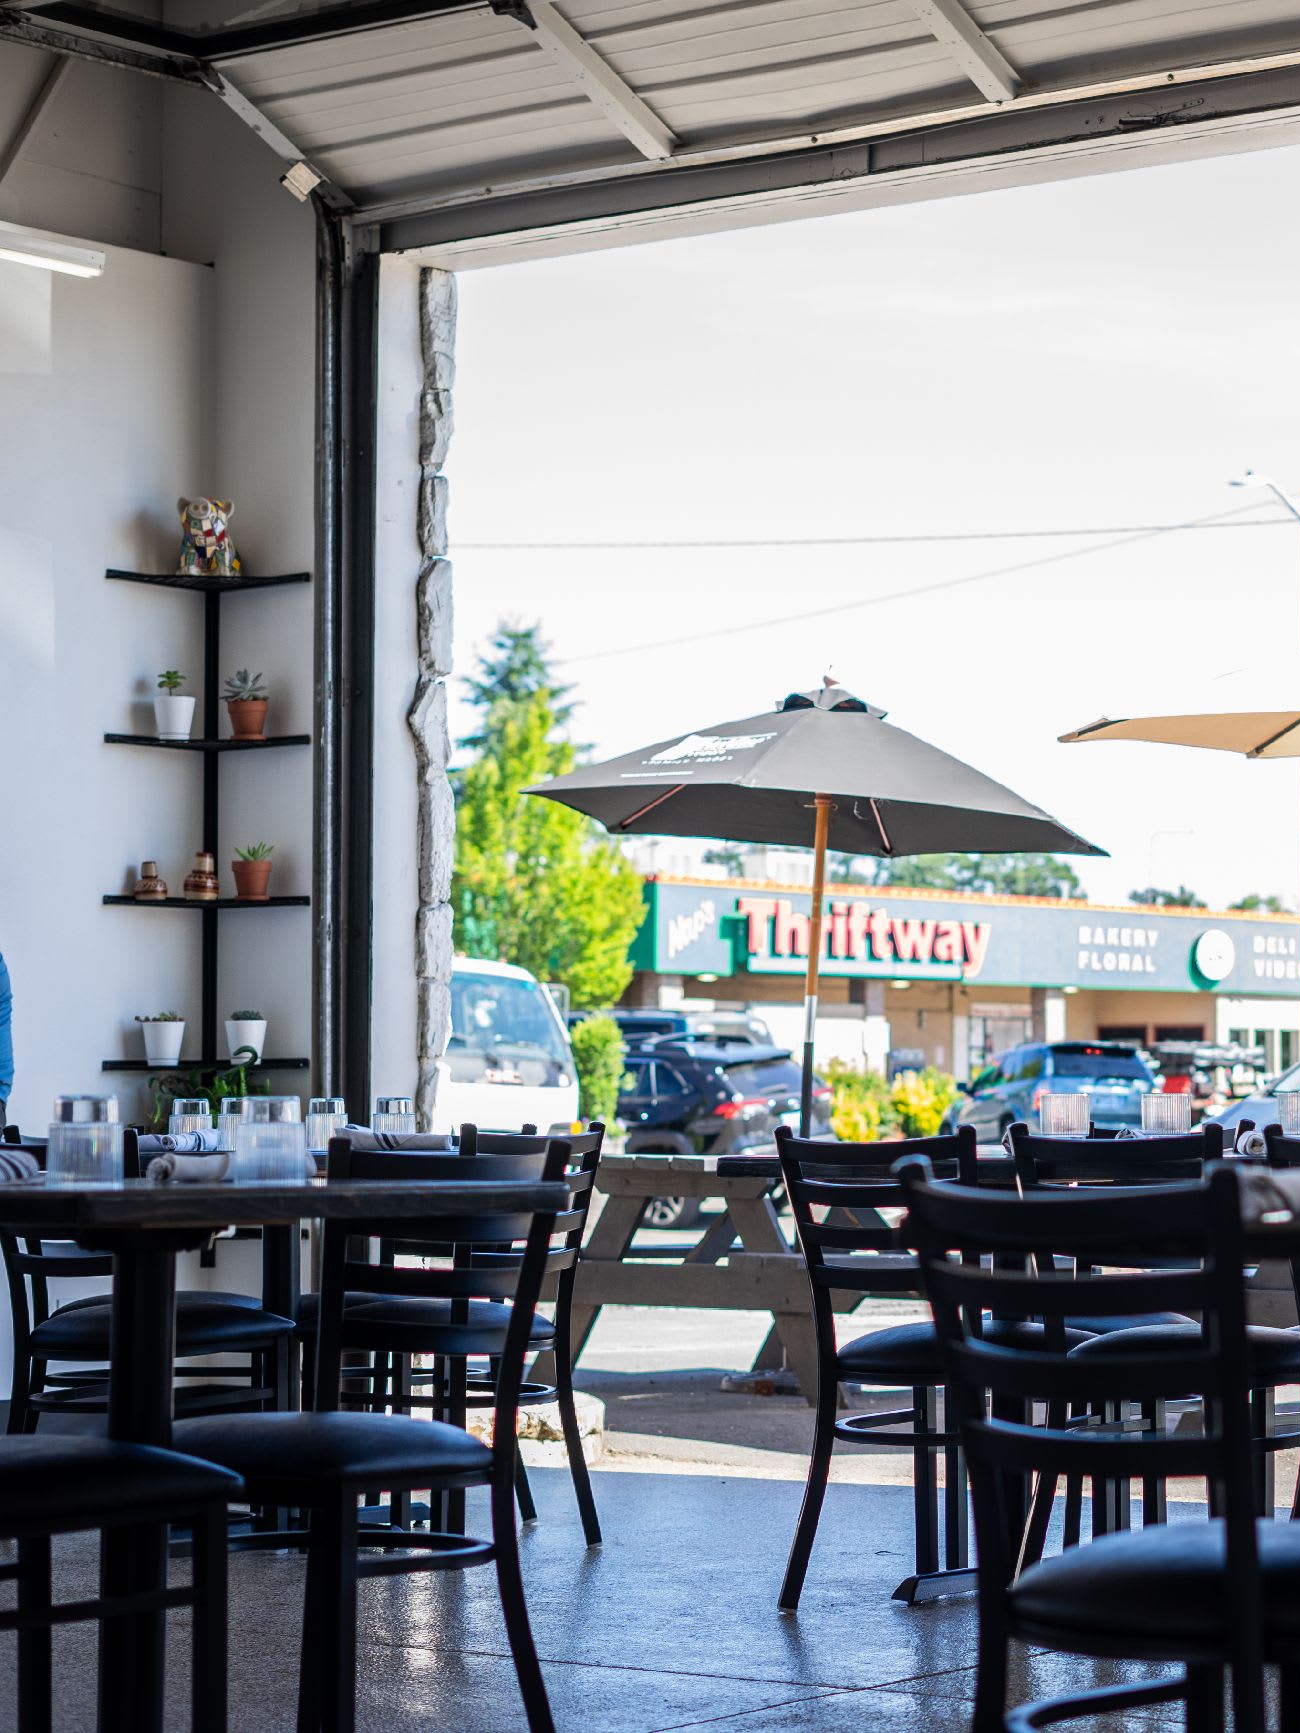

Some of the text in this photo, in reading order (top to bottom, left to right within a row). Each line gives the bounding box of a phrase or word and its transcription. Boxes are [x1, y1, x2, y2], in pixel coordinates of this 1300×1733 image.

[738, 898, 992, 978] Thriftway
[1078, 925, 1159, 948] BAKERY
[1253, 935, 1296, 955] DELI
[1078, 950, 1157, 973] FLORAL
